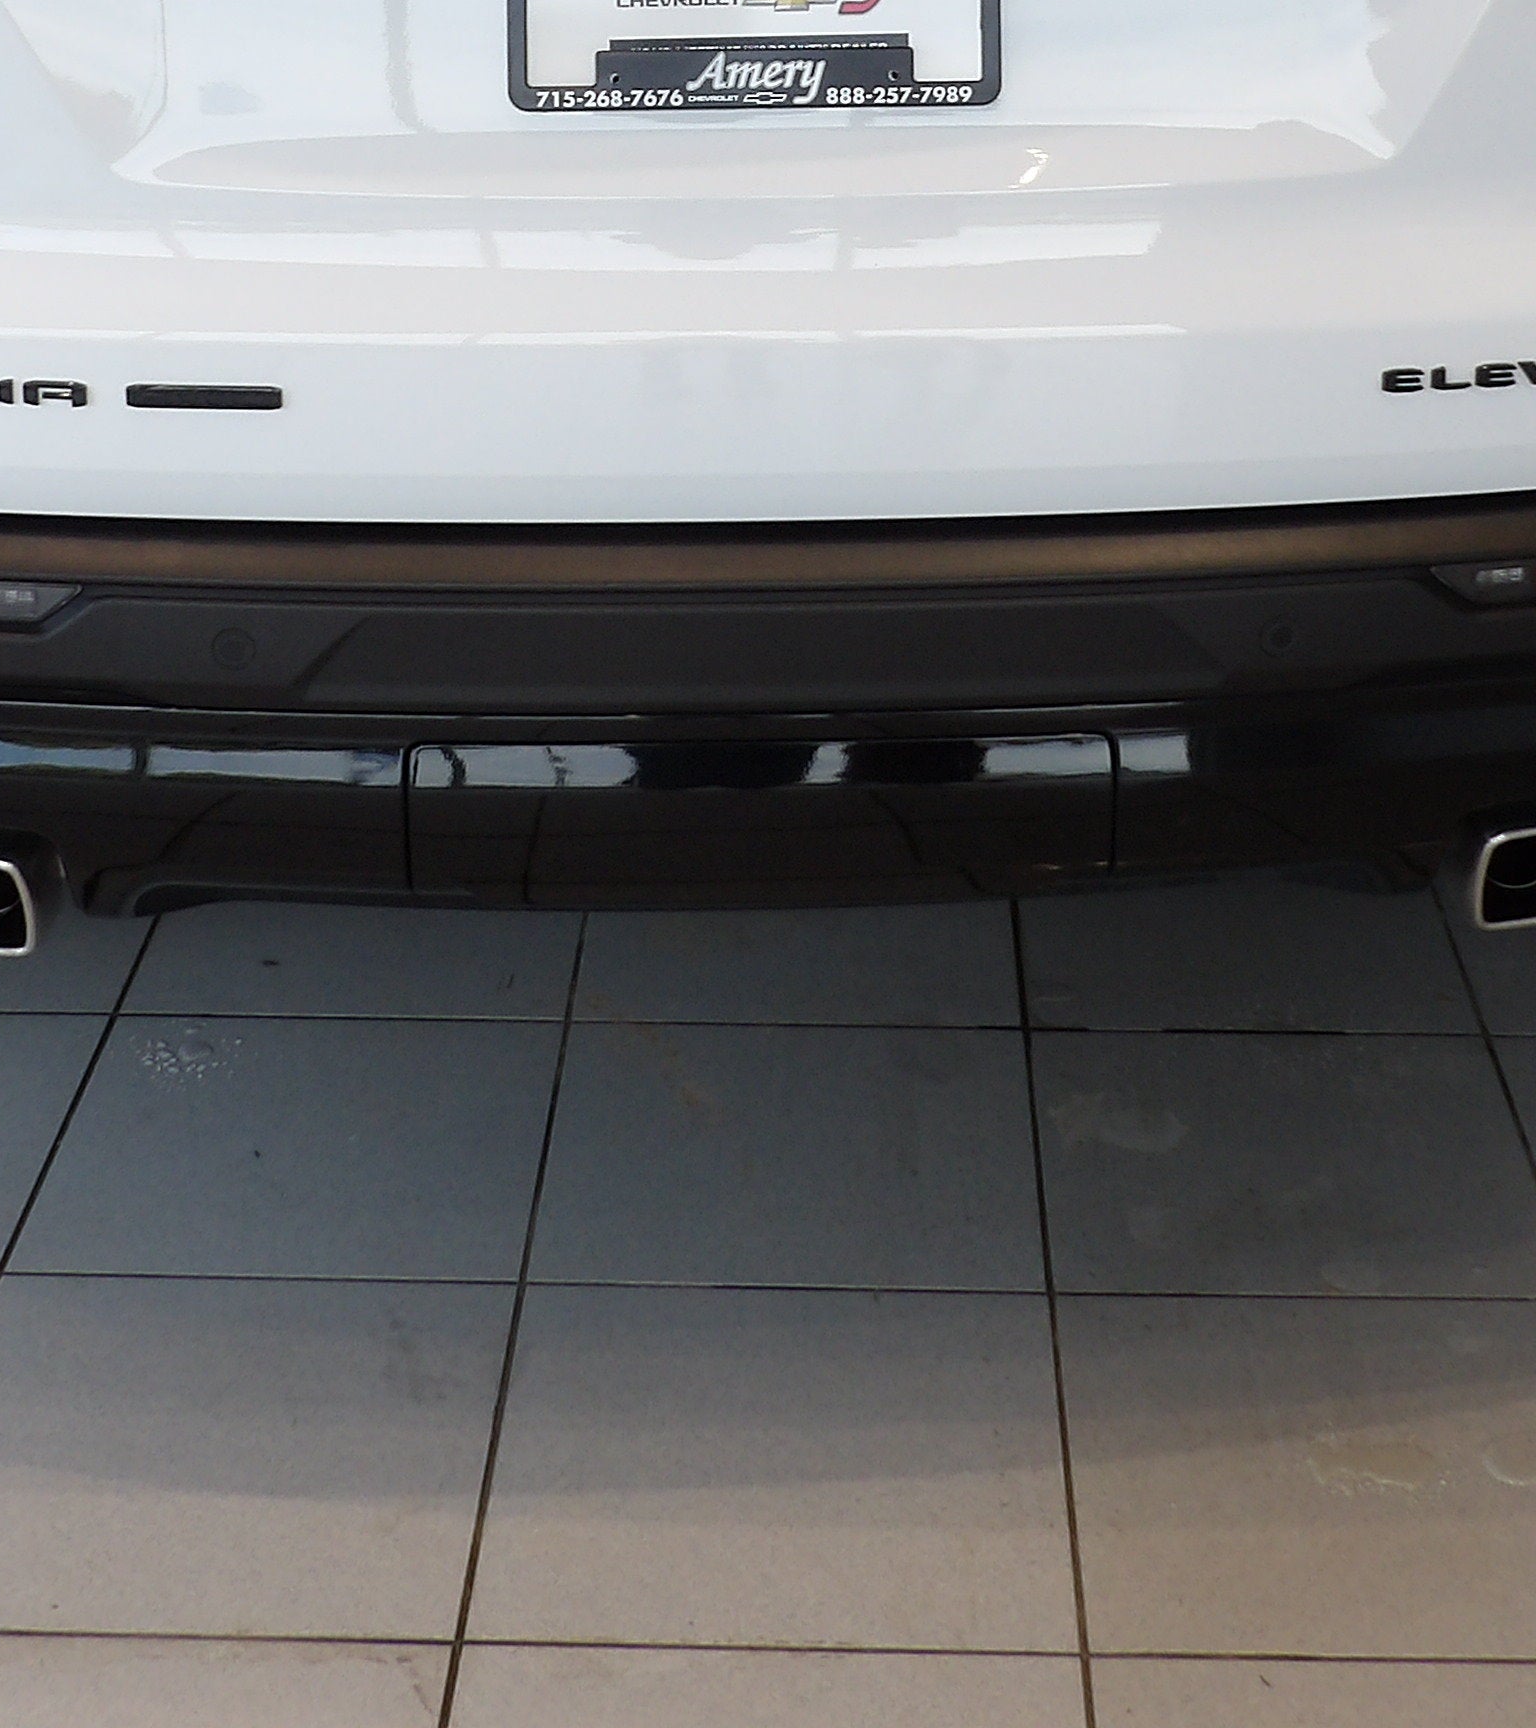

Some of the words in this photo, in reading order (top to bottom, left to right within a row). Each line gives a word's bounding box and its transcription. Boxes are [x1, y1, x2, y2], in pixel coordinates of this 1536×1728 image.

[685, 50, 828, 105] Amery
[536, 89, 685, 109] 715-268-7676
[687, 94, 739, 103] CHEVROLET
[825, 86, 973, 105] 888-257-7989
